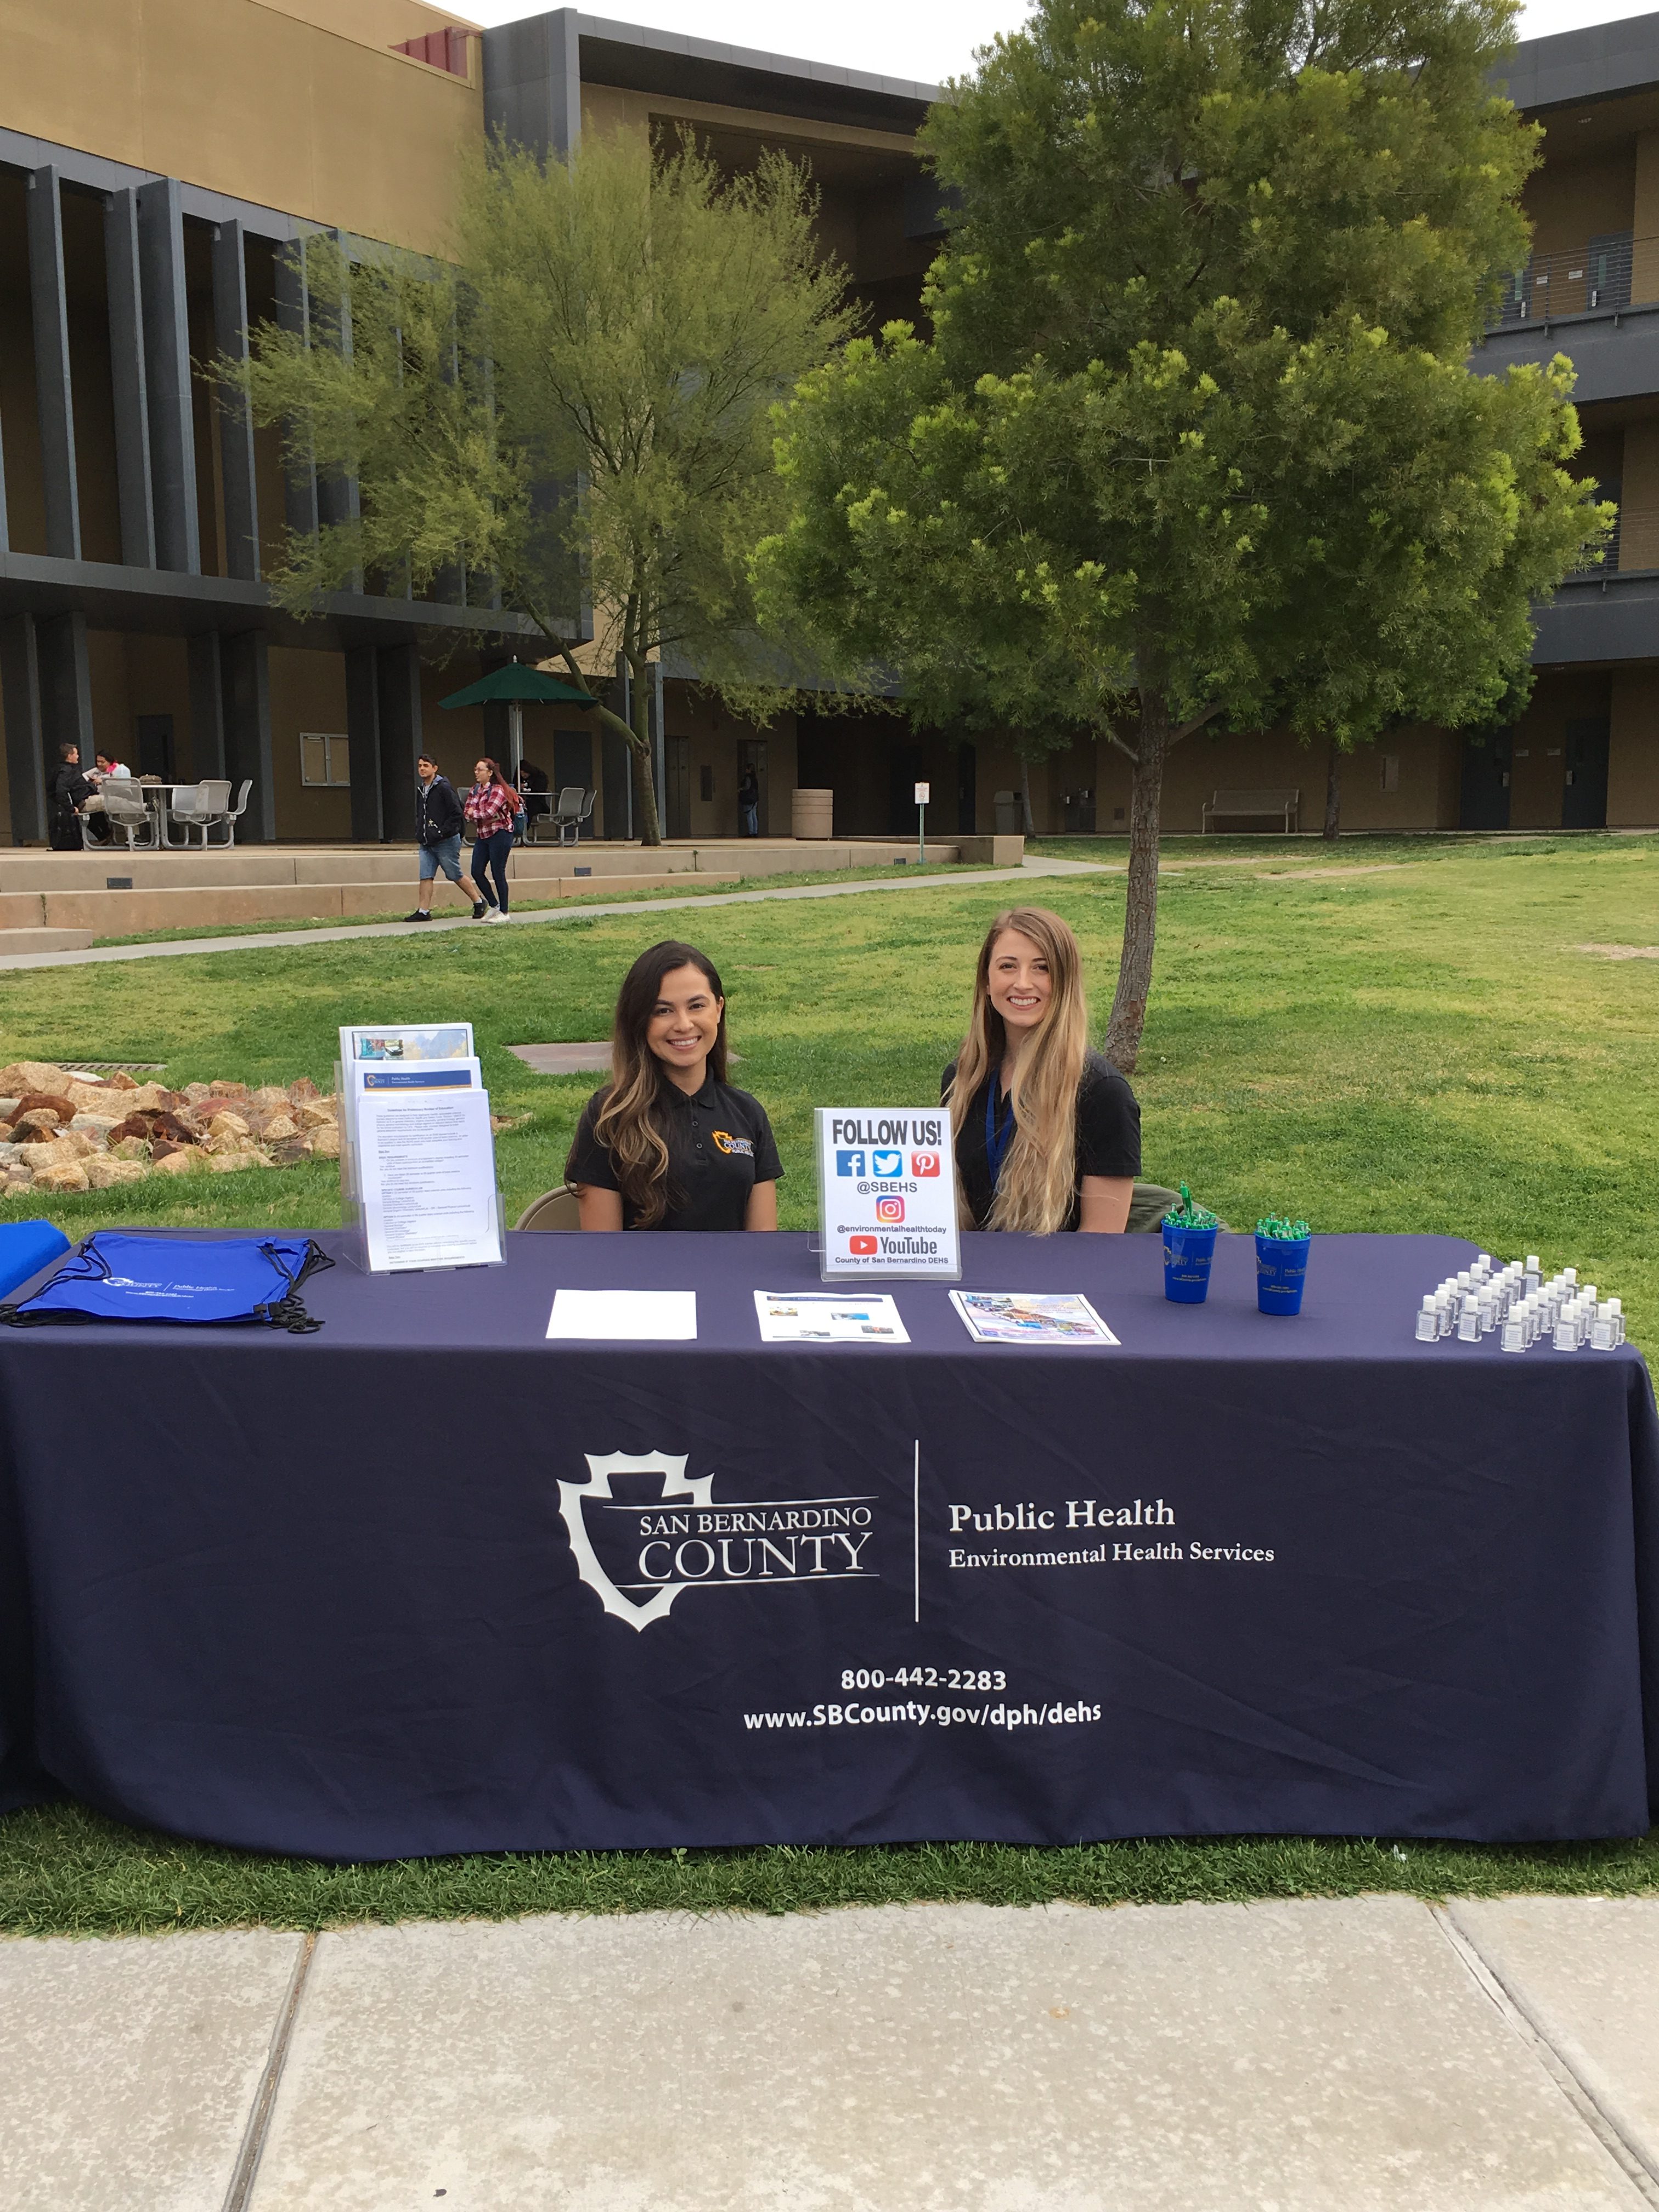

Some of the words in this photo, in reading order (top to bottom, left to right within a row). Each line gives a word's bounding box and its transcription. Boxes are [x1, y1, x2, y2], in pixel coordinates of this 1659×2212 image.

[833, 1119, 907, 1145] FOLLOW
[912, 1120, 942, 1146] US!
[857, 1182, 918, 1194] @SBEHS
[837, 1225, 947, 1234] @environmentalhealthtoday
[880, 1237, 937, 1254] YouTube
[640, 1514, 690, 1536] SAN
[697, 1506, 872, 1534] BERNARDINO
[948, 1503, 1055, 1532] Public
[1065, 1498, 1176, 1528] Health
[638, 1532, 873, 1579] COUNTY
[949, 1544, 1106, 1567] Environmental
[1112, 1542, 1183, 1561] Health
[1190, 1542, 1274, 1561] Services
[841, 1667, 1006, 1690] 800-442-2283
[744, 1701, 1101, 1730] www.SBCounty.gov/dph/dehs
